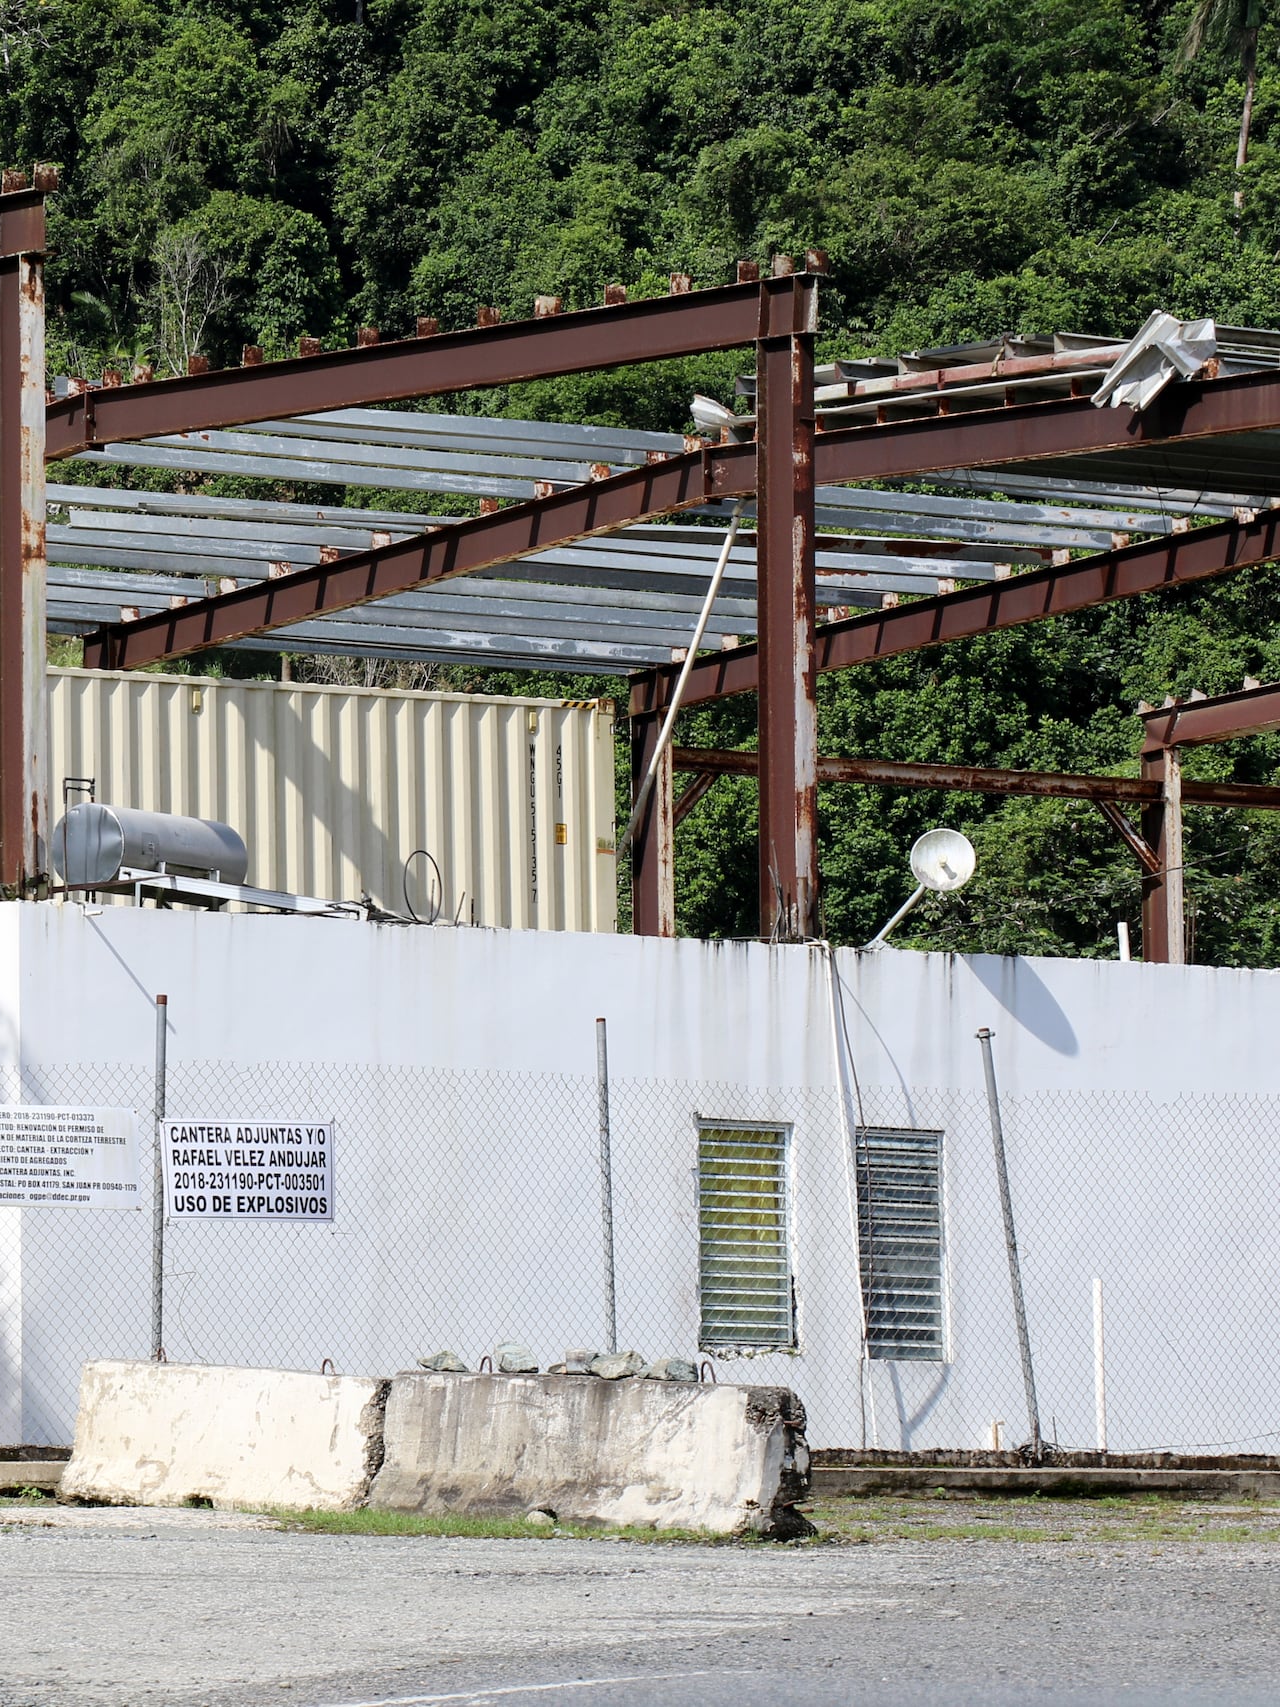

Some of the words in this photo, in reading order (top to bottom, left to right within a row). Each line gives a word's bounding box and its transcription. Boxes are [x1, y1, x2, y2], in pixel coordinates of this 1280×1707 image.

[17, 1123, 57, 1132] RENOVACIÓN
[16, 1134, 46, 1142] MATERIAL
[94, 1137, 126, 1145] TERRESTRE
[171, 1127, 232, 1143] CANTERA
[237, 1128, 302, 1144] ADJUNTAS
[307, 1128, 325, 1145] Y/O
[17, 1146, 45, 1154] CANTERA
[20, 1156, 28, 1164] DE
[30, 1157, 67, 1165] AGREGADOS
[173, 1150, 221, 1166] RAFAEL
[225, 1150, 265, 1166] VELEZ
[270, 1151, 326, 1168] ANDUJAR
[62, 1181, 75, 1189] SAN
[102, 1183, 137, 1191] 00940-1179
[175, 1172, 325, 1191] 2018-231190-PCT-003501
[175, 1196, 206, 1212] USO
[213, 1196, 231, 1212] DE
[237, 1196, 327, 1213] EXPLOSIVOS
